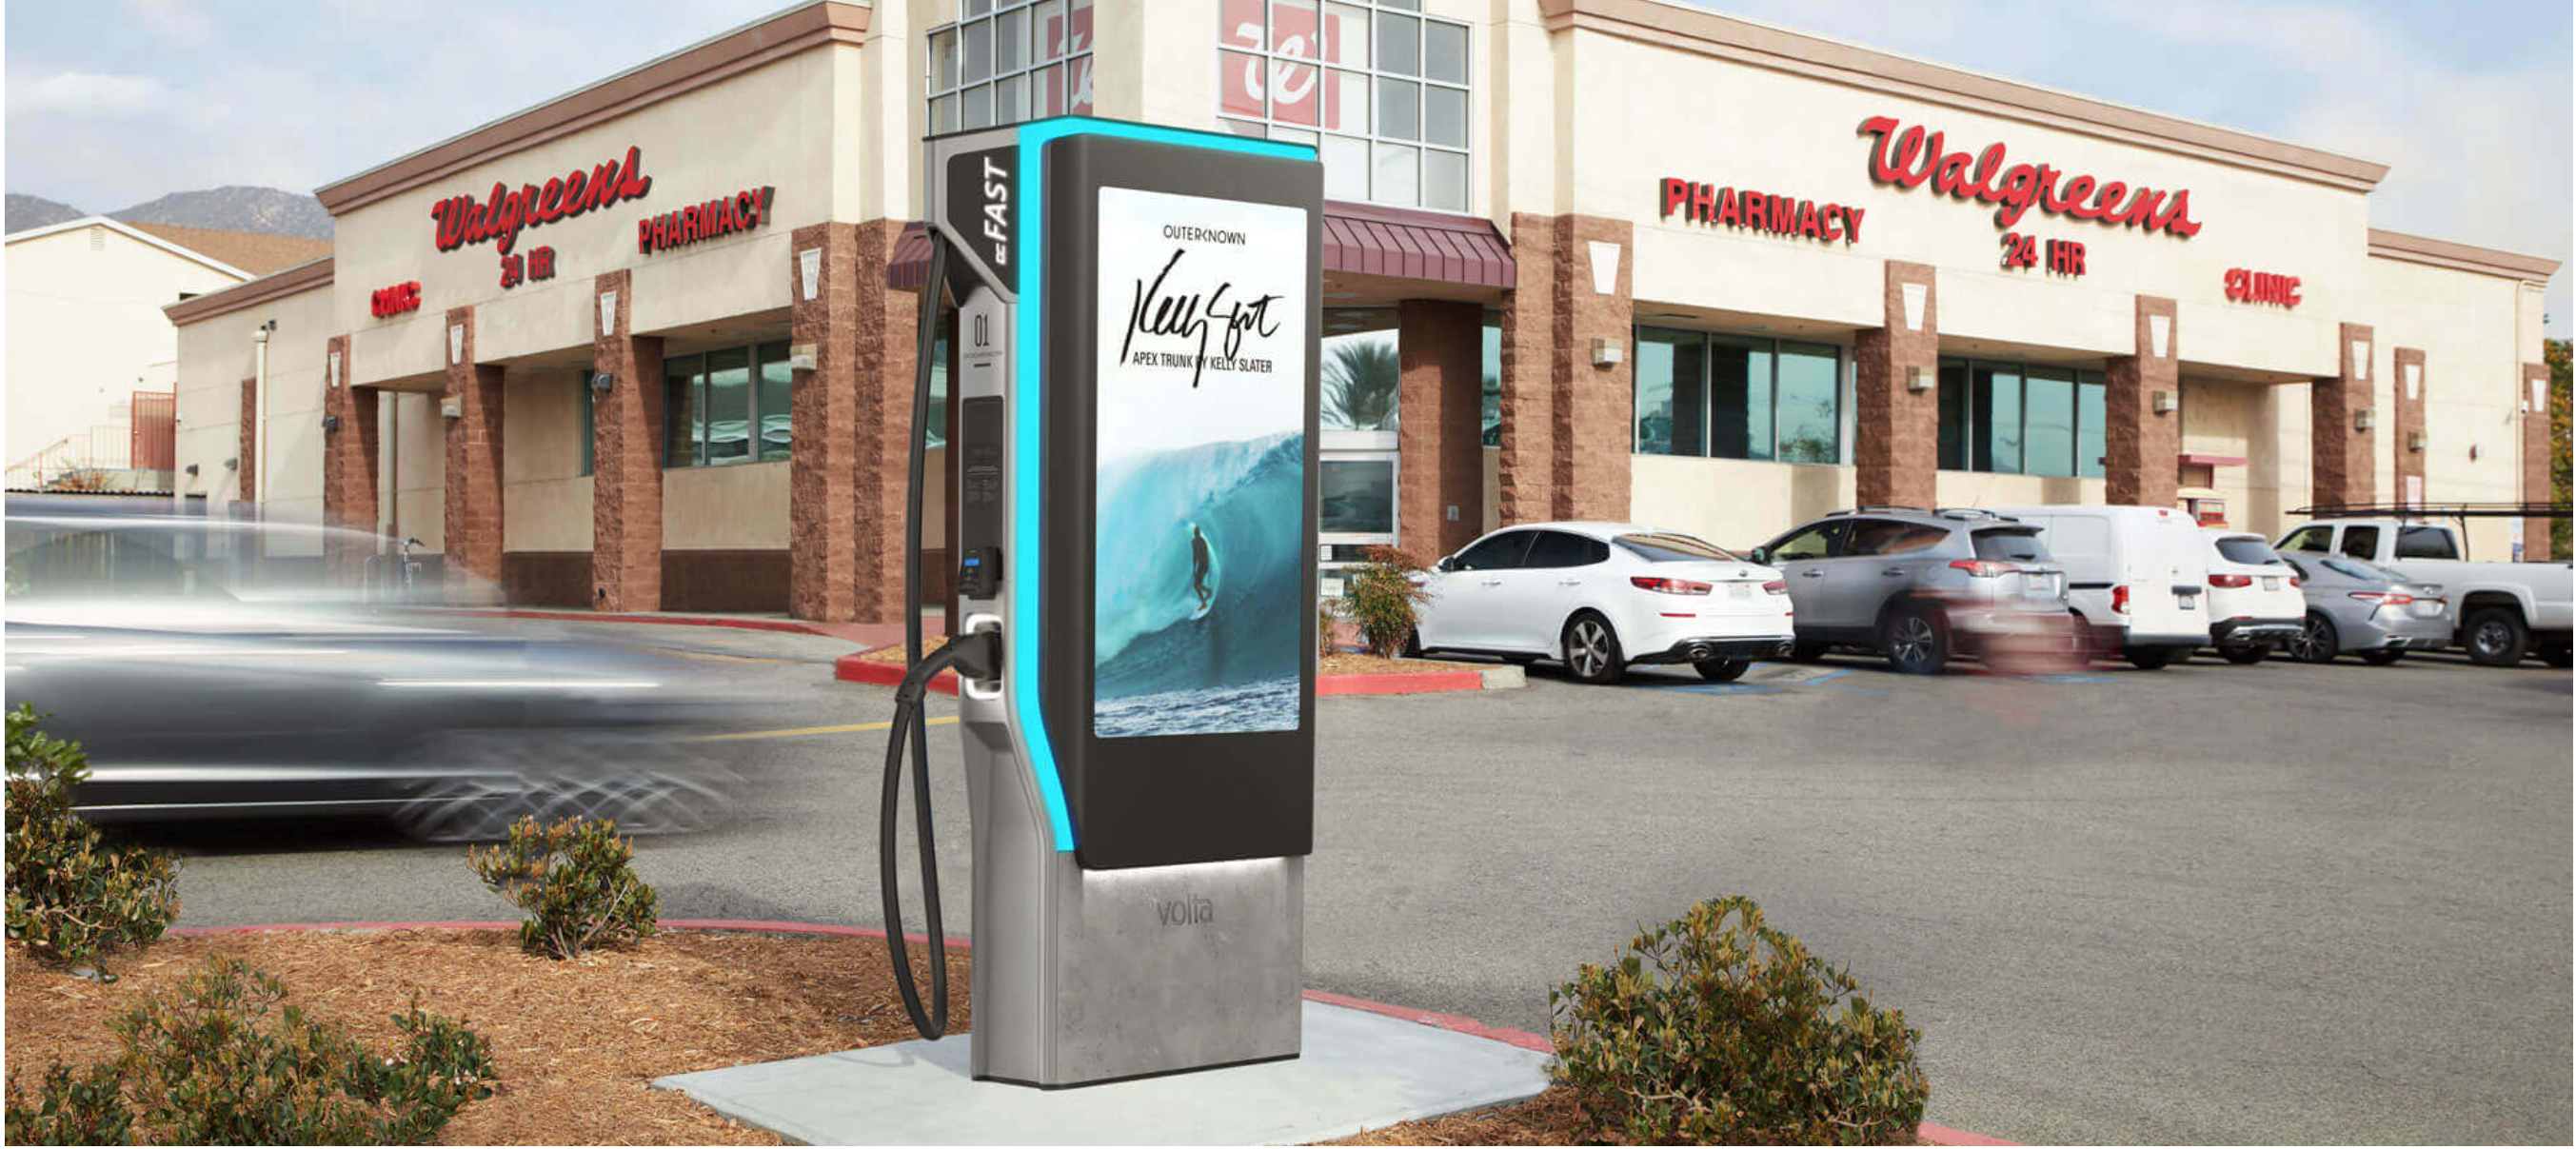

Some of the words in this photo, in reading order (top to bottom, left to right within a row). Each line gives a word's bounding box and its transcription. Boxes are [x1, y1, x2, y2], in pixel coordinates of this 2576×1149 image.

[1856, 115, 2201, 236] Walgreens
[431, 146, 652, 254] Walgreens
[639, 186, 775, 254] PHARMACY
[983, 157, 1008, 241] FAST
[1660, 178, 1866, 244] PHARMACY
[500, 253, 523, 287] 24
[528, 246, 555, 281] HR
[2000, 232, 2038, 271] 24
[2046, 238, 2086, 276] HR
[2224, 267, 2302, 307] CLINIC
[975, 314, 990, 347] 01
[1133, 351, 1158, 366] APEX
[1160, 352, 1194, 368] TRUNK
[1210, 356, 1238, 371] KELLY
[1239, 357, 1273, 373] SLATER
[1157, 894, 1214, 926] volta
